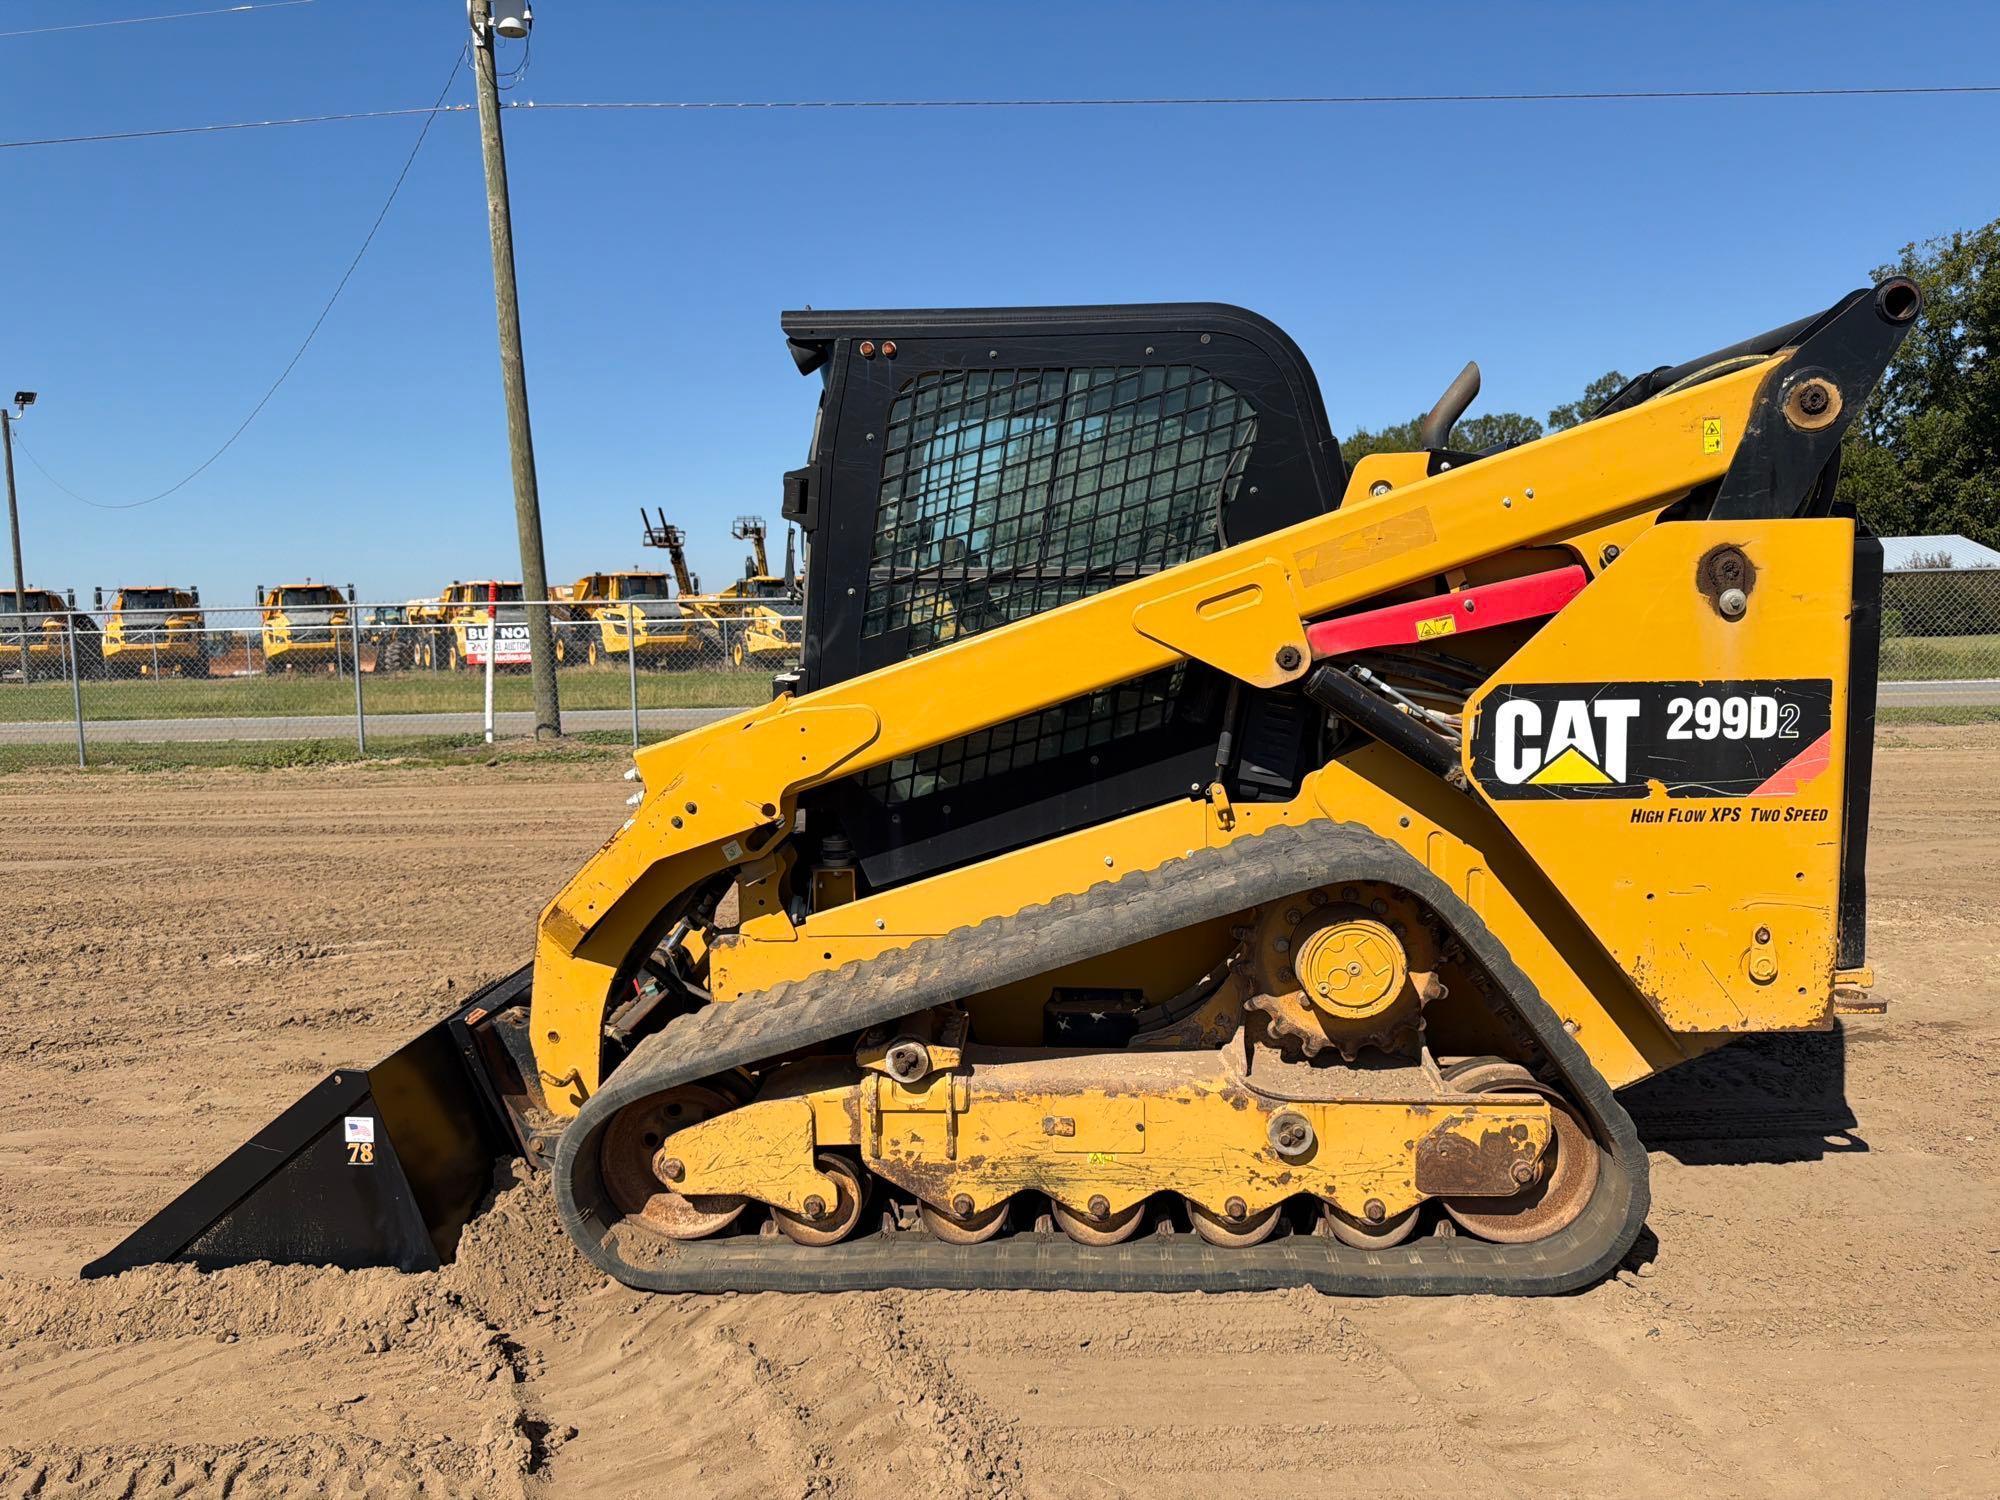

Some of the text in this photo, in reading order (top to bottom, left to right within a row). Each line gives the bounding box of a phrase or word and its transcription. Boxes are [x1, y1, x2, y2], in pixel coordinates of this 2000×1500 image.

[1666, 696, 1801, 740] 299D2
[1495, 699, 1640, 785] CAT
[1709, 807, 1742, 823] XPS
